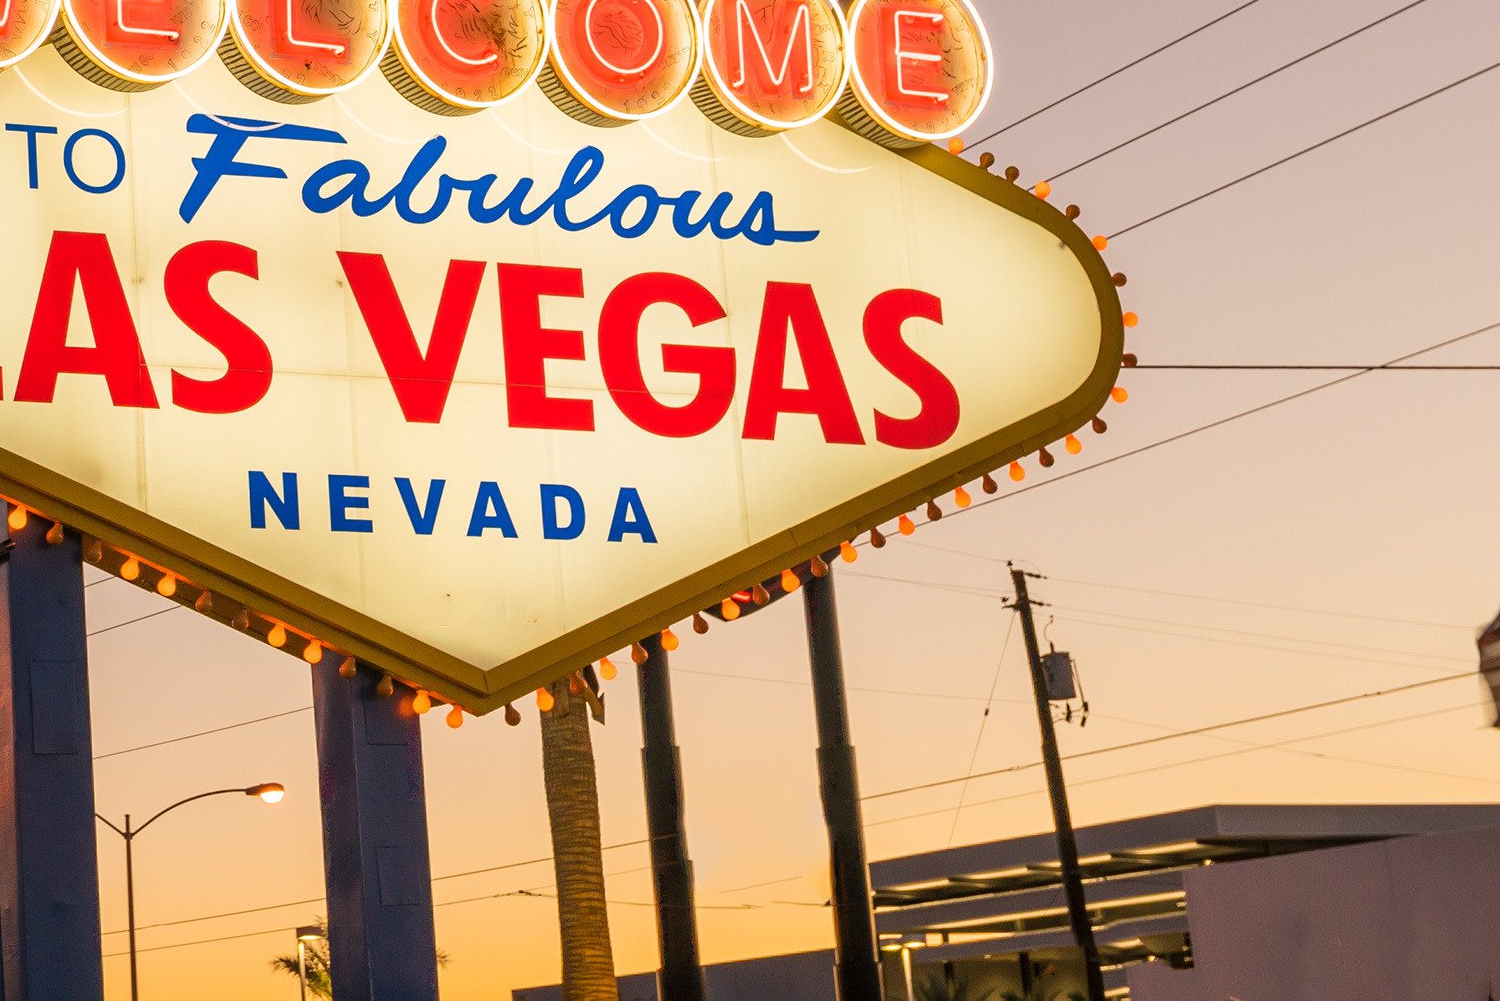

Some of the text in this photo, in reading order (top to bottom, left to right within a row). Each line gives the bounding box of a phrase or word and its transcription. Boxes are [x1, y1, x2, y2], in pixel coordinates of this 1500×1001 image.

[6, 114, 820, 246] TO Fabulous
[338, 252, 960, 450] VEGAS
[249, 471, 657, 543] NEVADA
